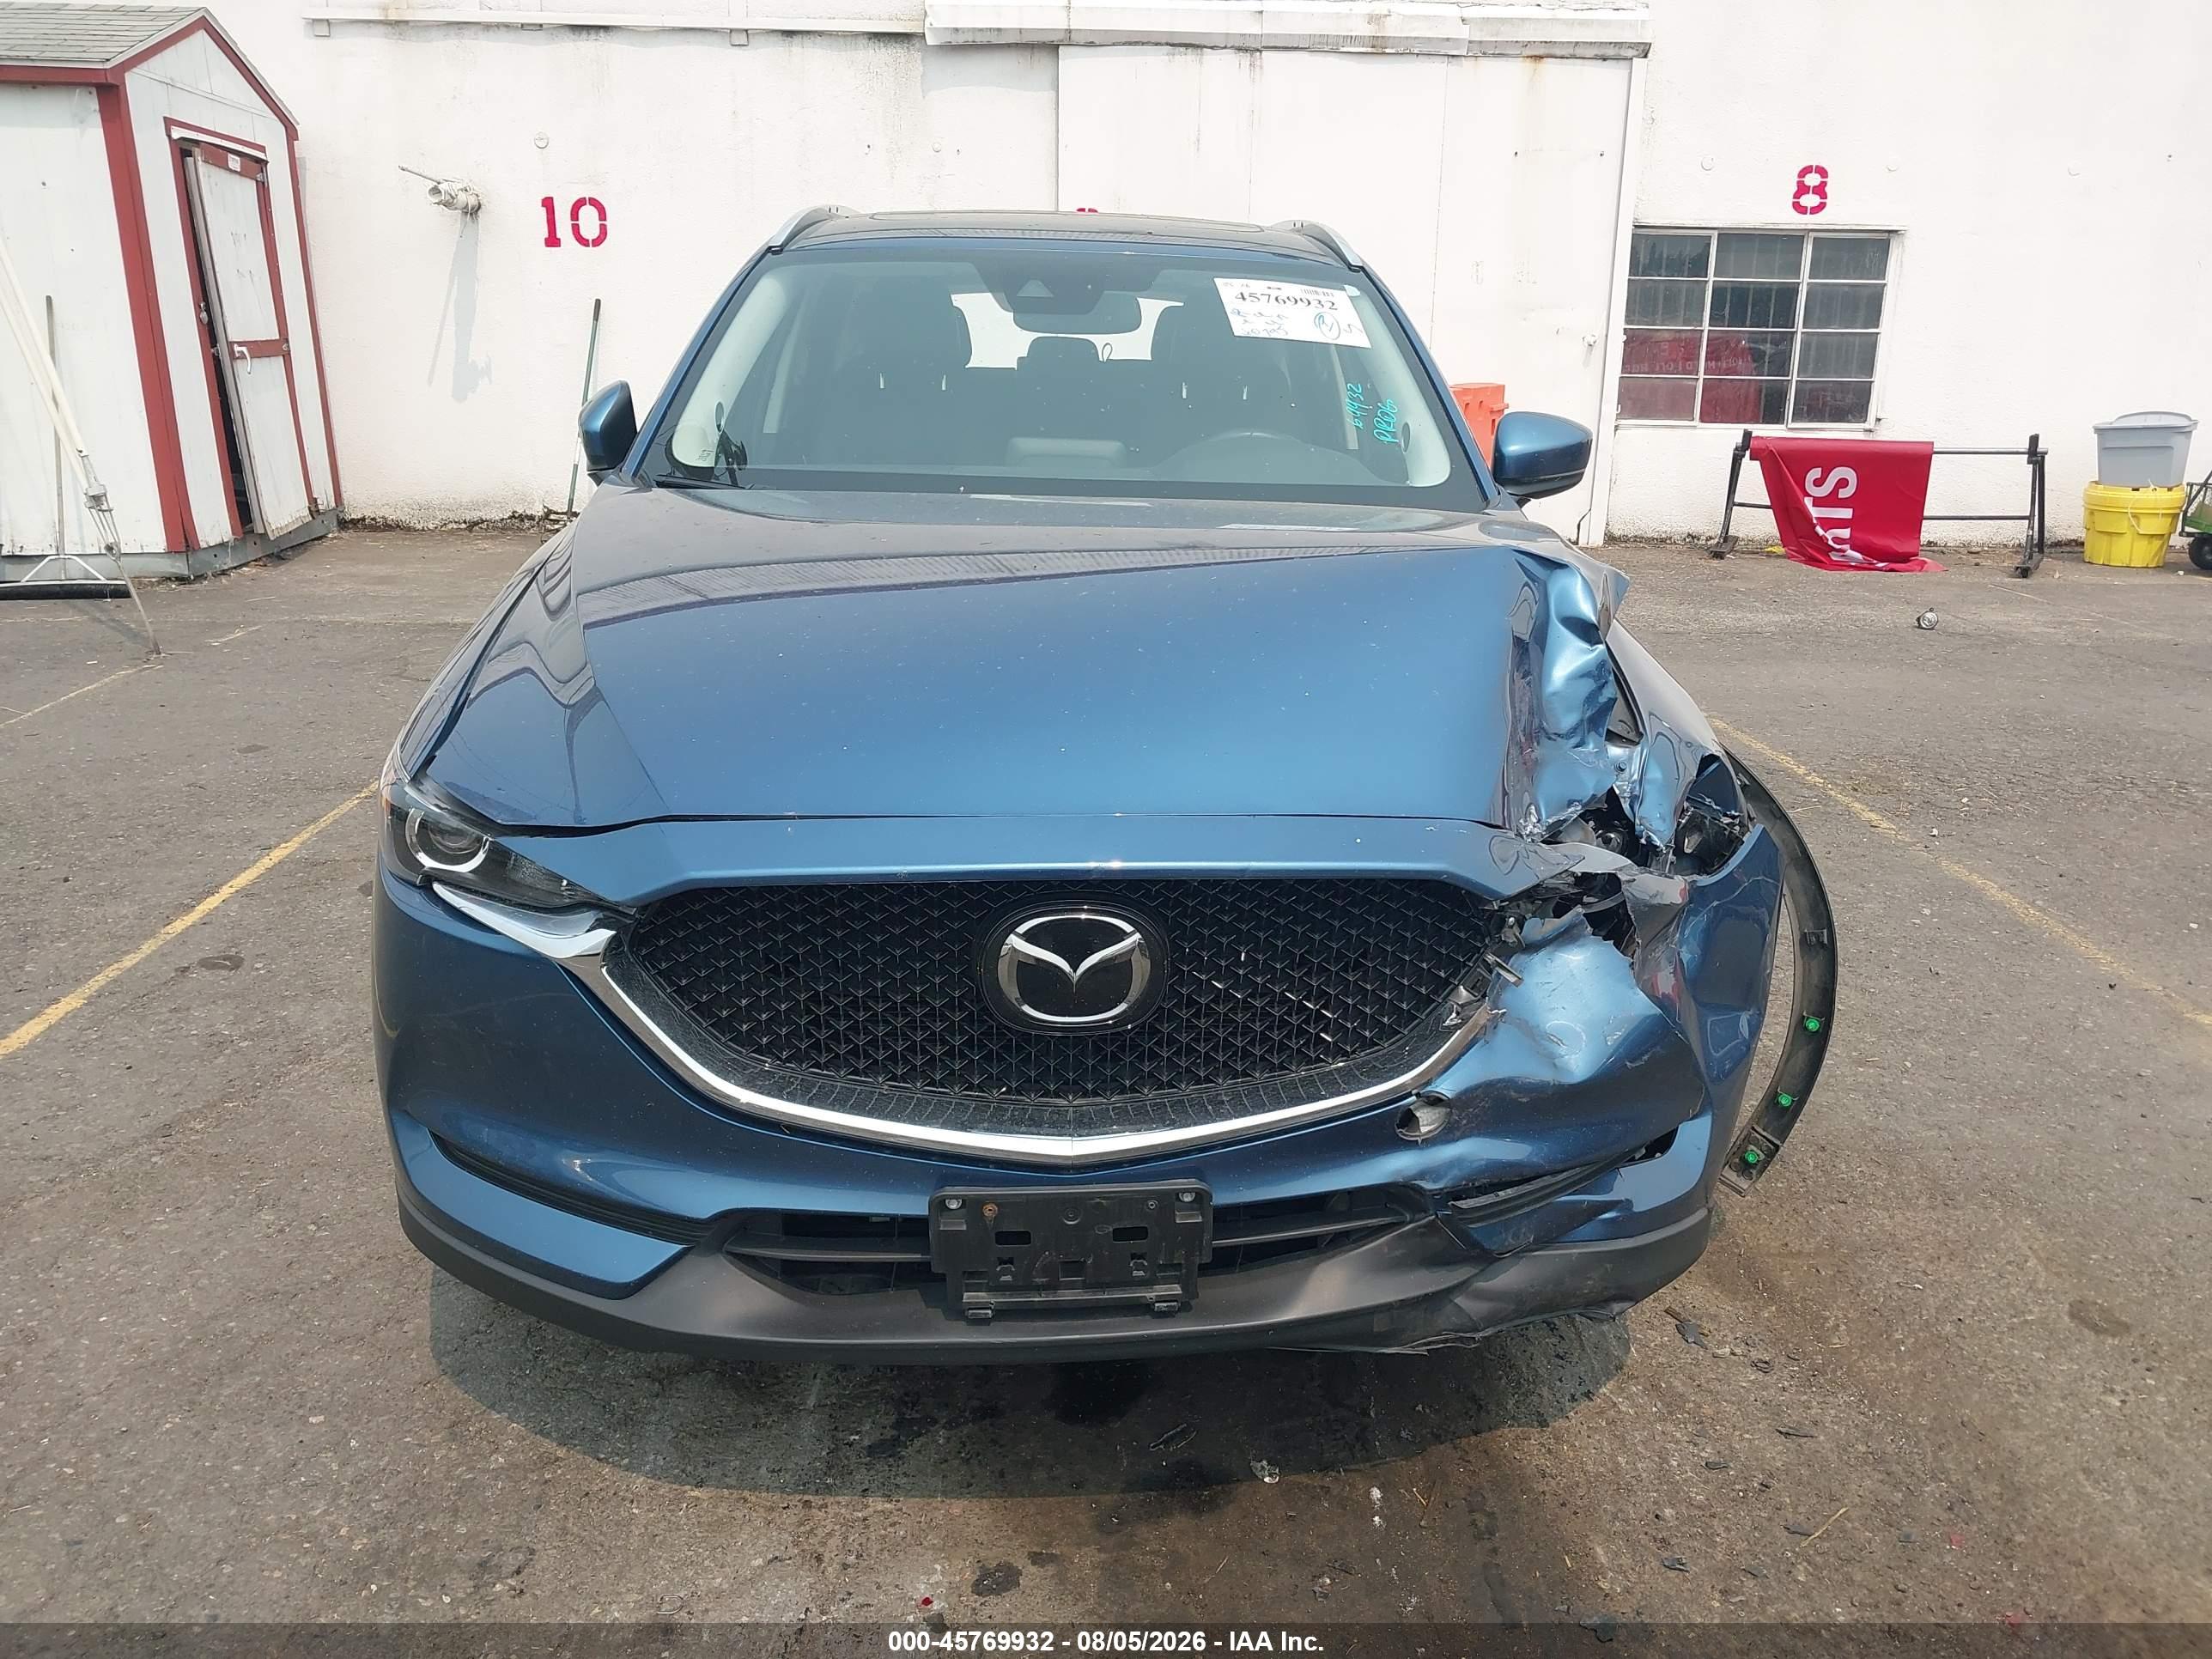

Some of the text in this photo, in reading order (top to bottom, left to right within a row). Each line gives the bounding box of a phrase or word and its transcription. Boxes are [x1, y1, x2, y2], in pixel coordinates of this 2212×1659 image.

[1792, 164, 1829, 216] 8
[541, 196, 608, 247] 10
[1235, 291, 1340, 311] 45769932
